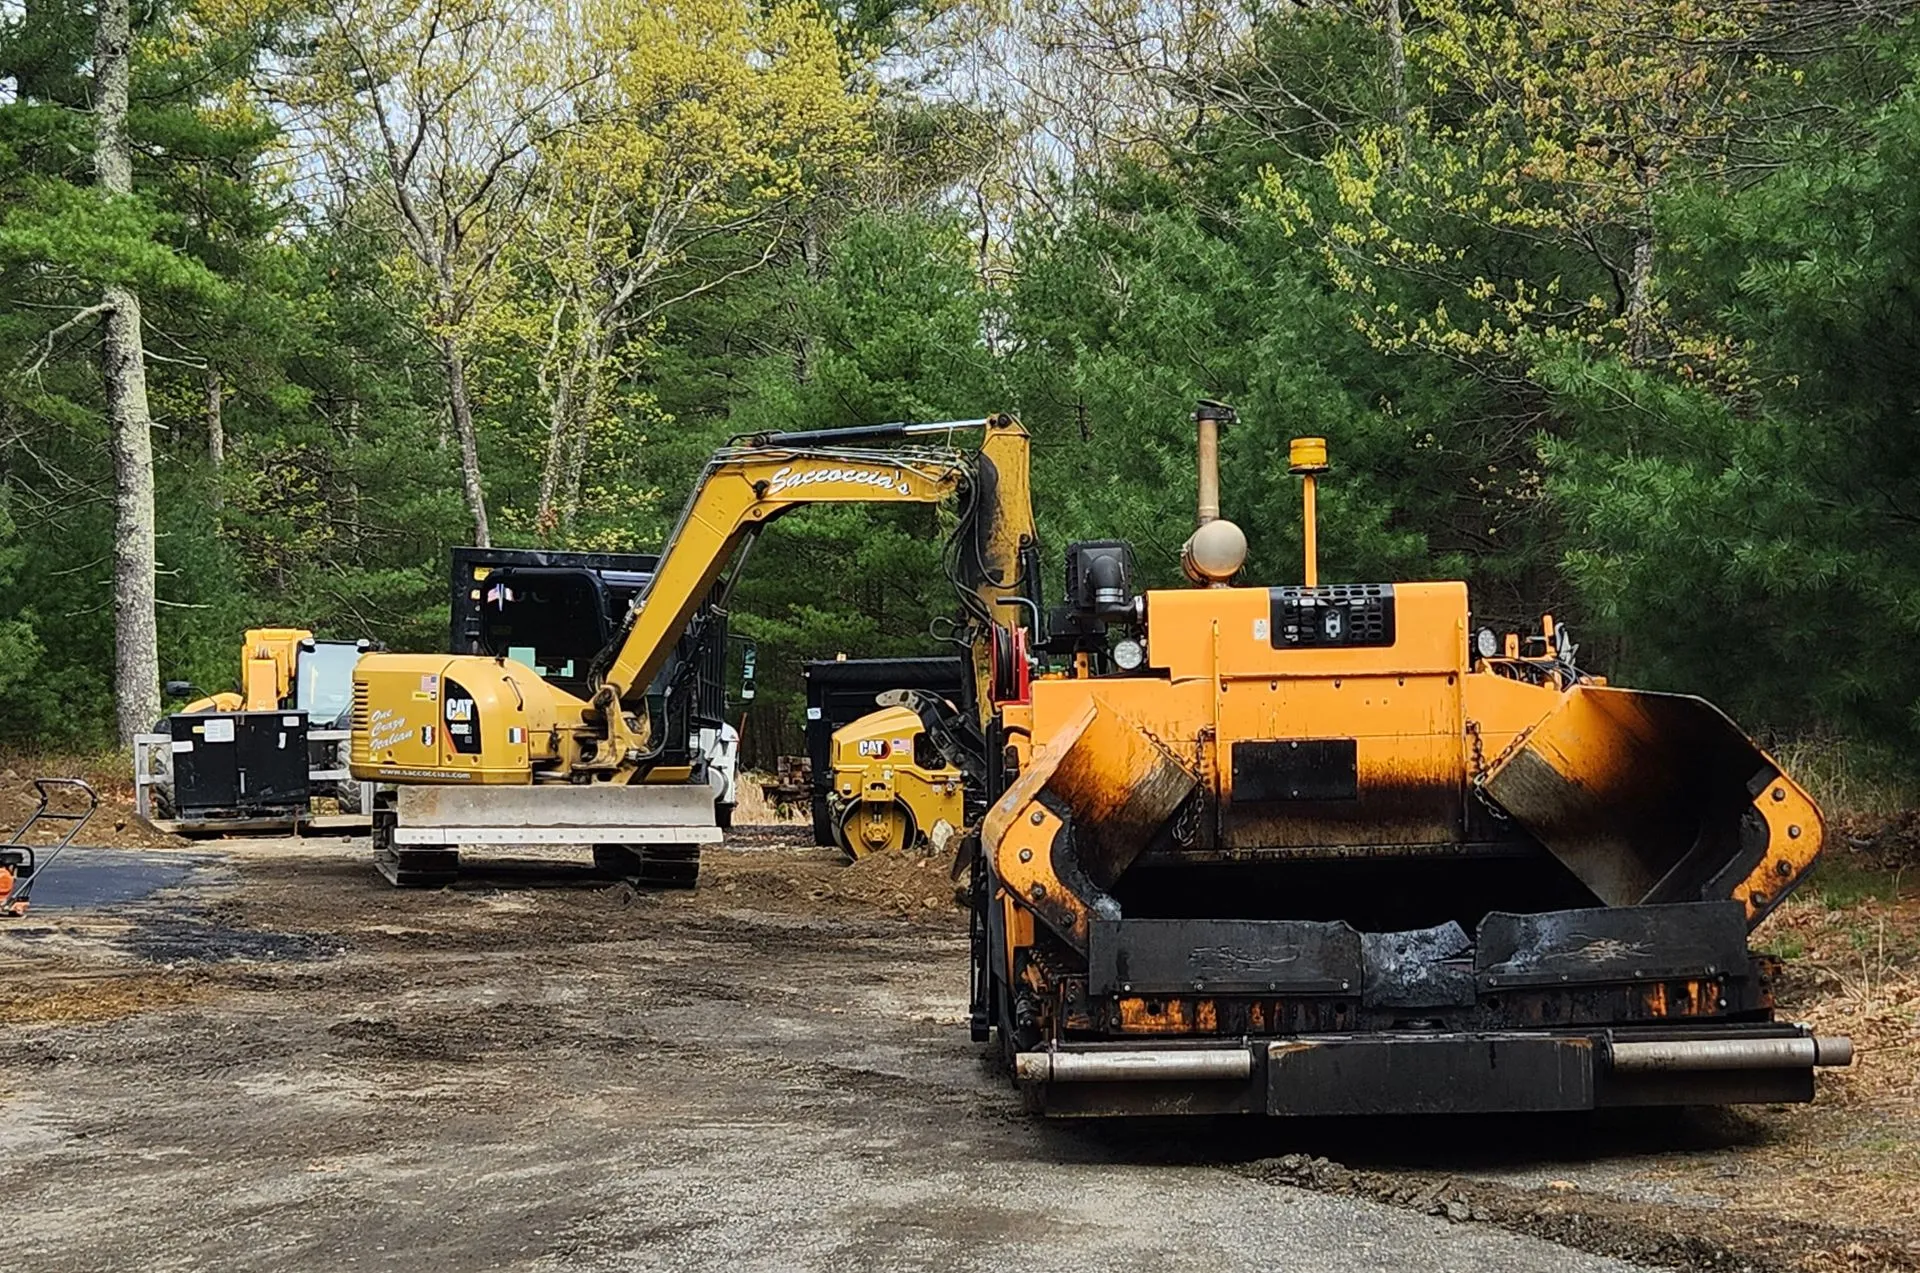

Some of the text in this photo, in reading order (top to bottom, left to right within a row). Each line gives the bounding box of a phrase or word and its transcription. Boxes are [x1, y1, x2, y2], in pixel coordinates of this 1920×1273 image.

[767, 467, 911, 495] Saccoccia's
[371, 709, 393, 722] One
[446, 698, 474, 720] CAT
[371, 717, 406, 737] Crazy
[370, 729, 414, 750] Italian
[859, 740, 884, 756] CAT
[379, 768, 472, 779] www.saccoccias.com
